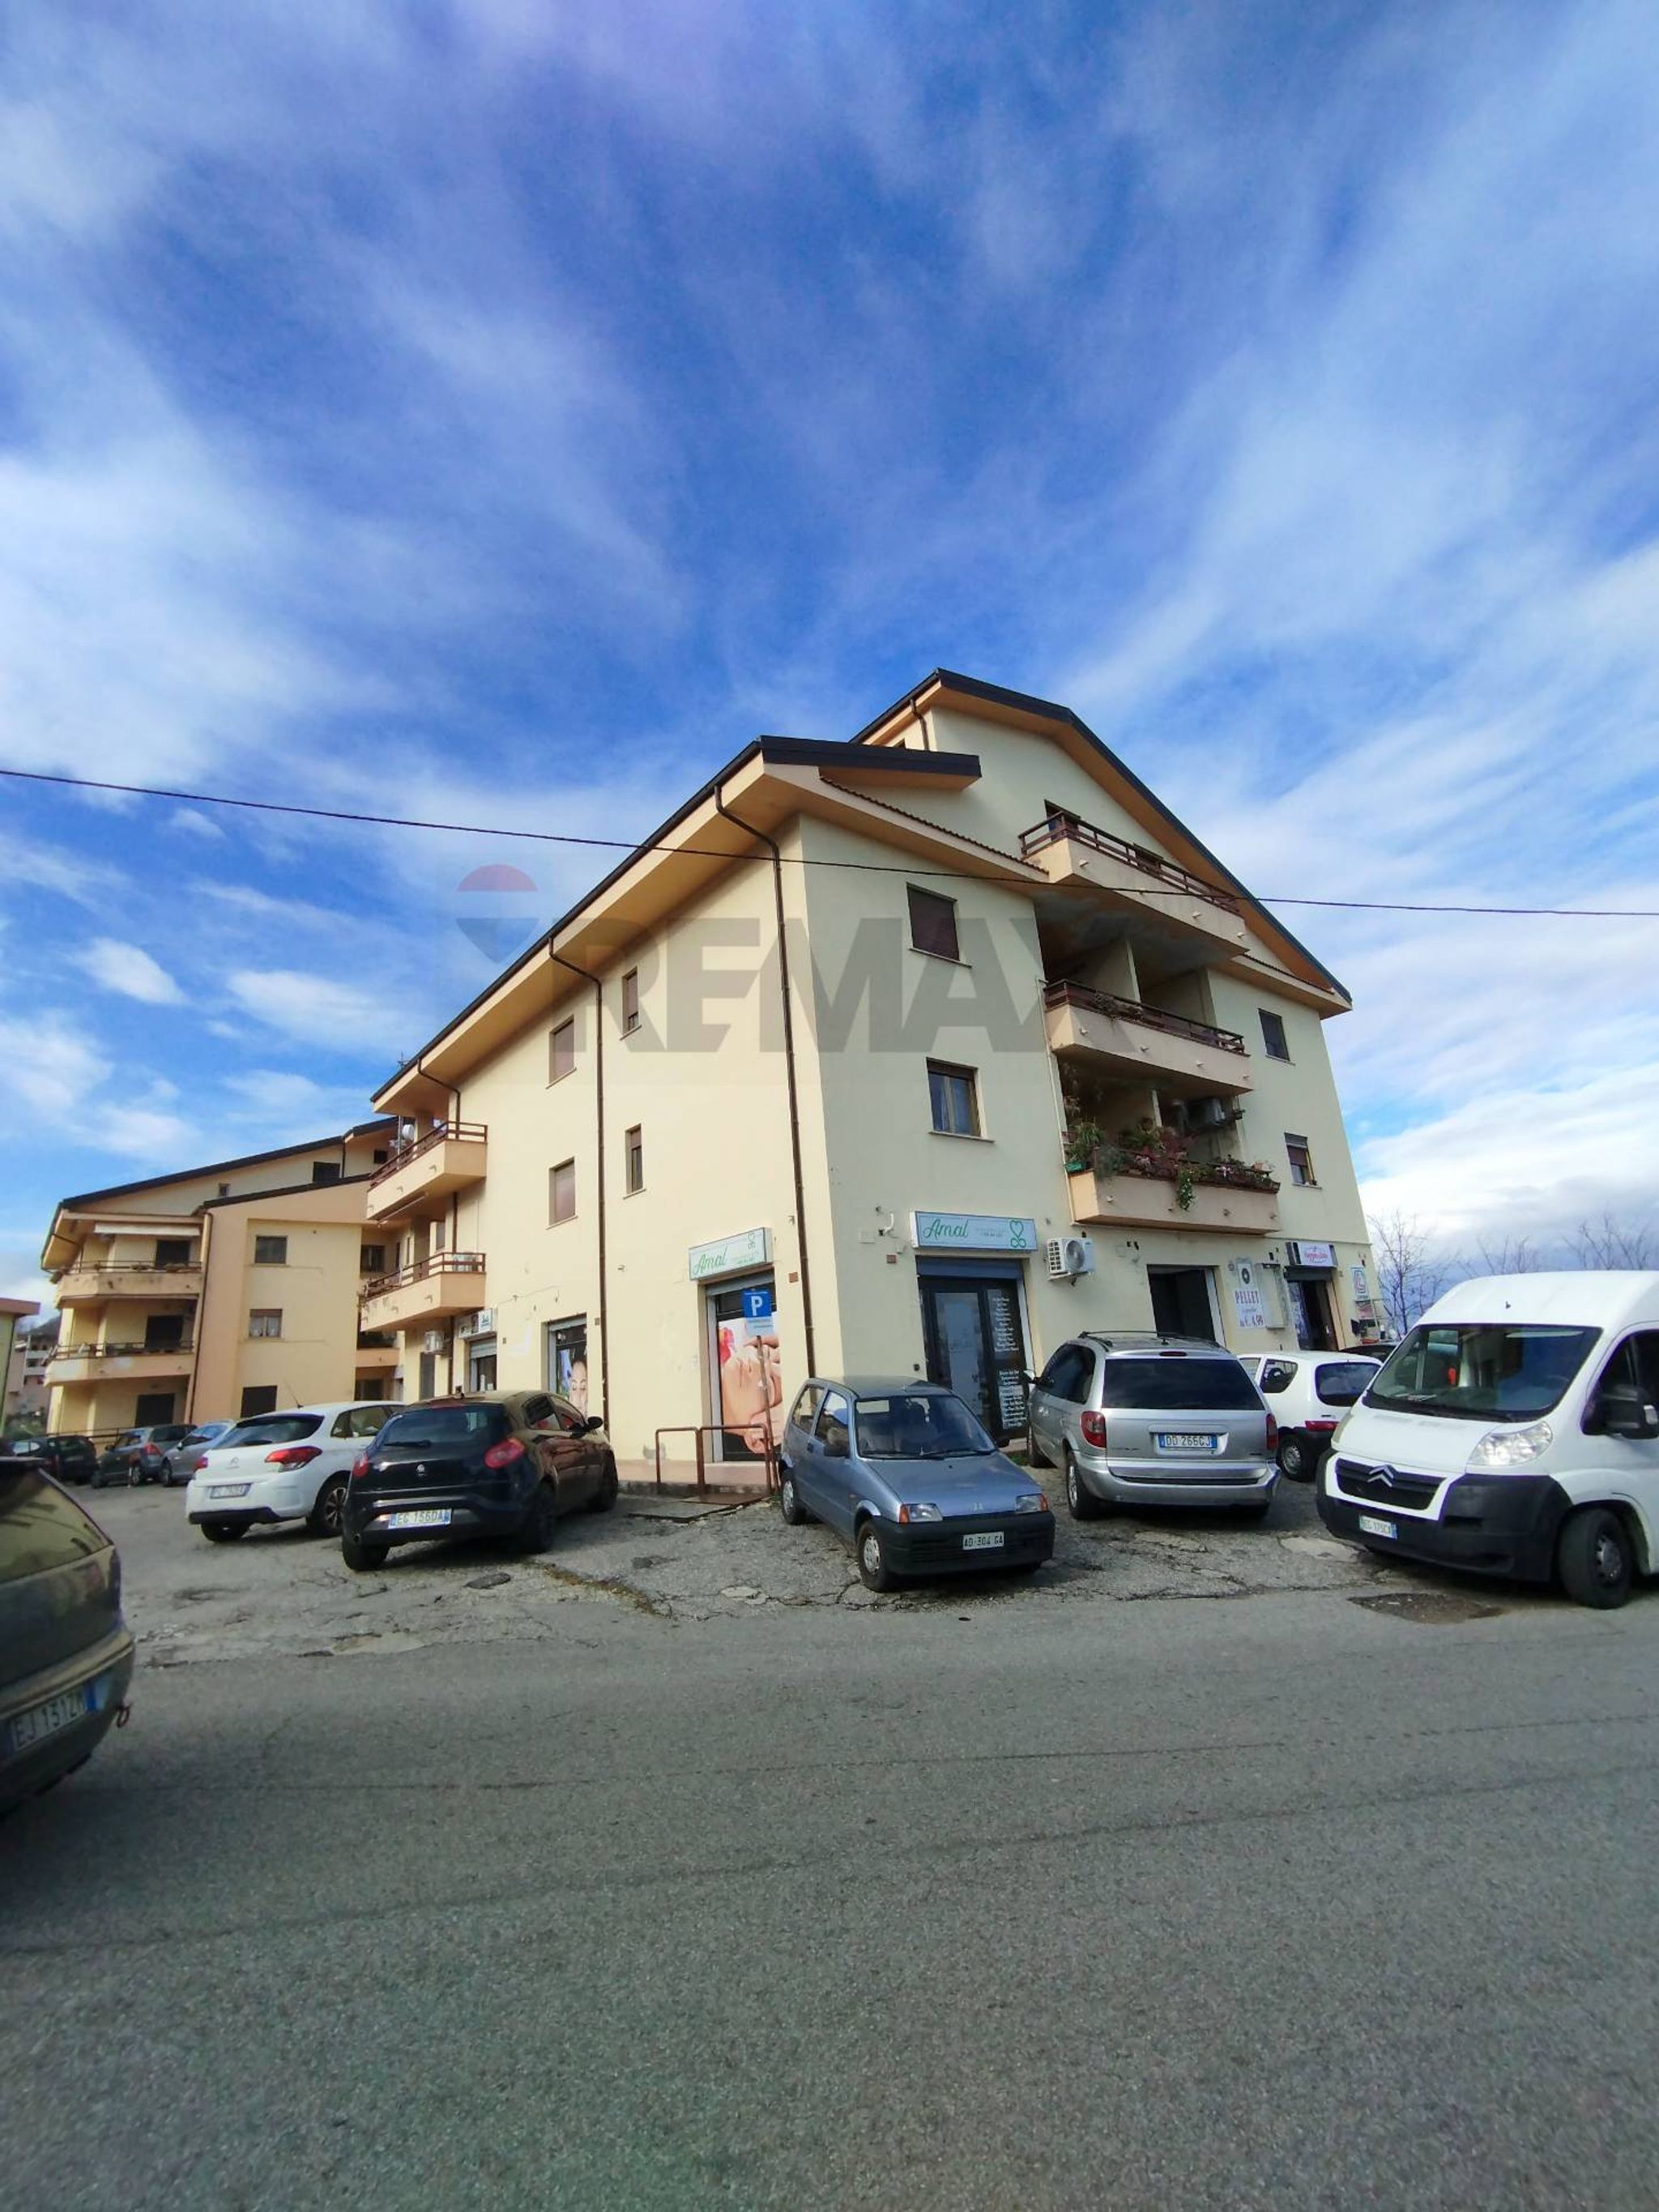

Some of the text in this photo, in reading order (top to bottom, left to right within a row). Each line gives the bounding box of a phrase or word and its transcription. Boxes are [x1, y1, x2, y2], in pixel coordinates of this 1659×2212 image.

[923, 1218, 968, 1239] Amal
[693, 1245, 728, 1274] Amal
[751, 1296, 762, 1316] P
[1235, 1290, 1259, 1303] PELLET
